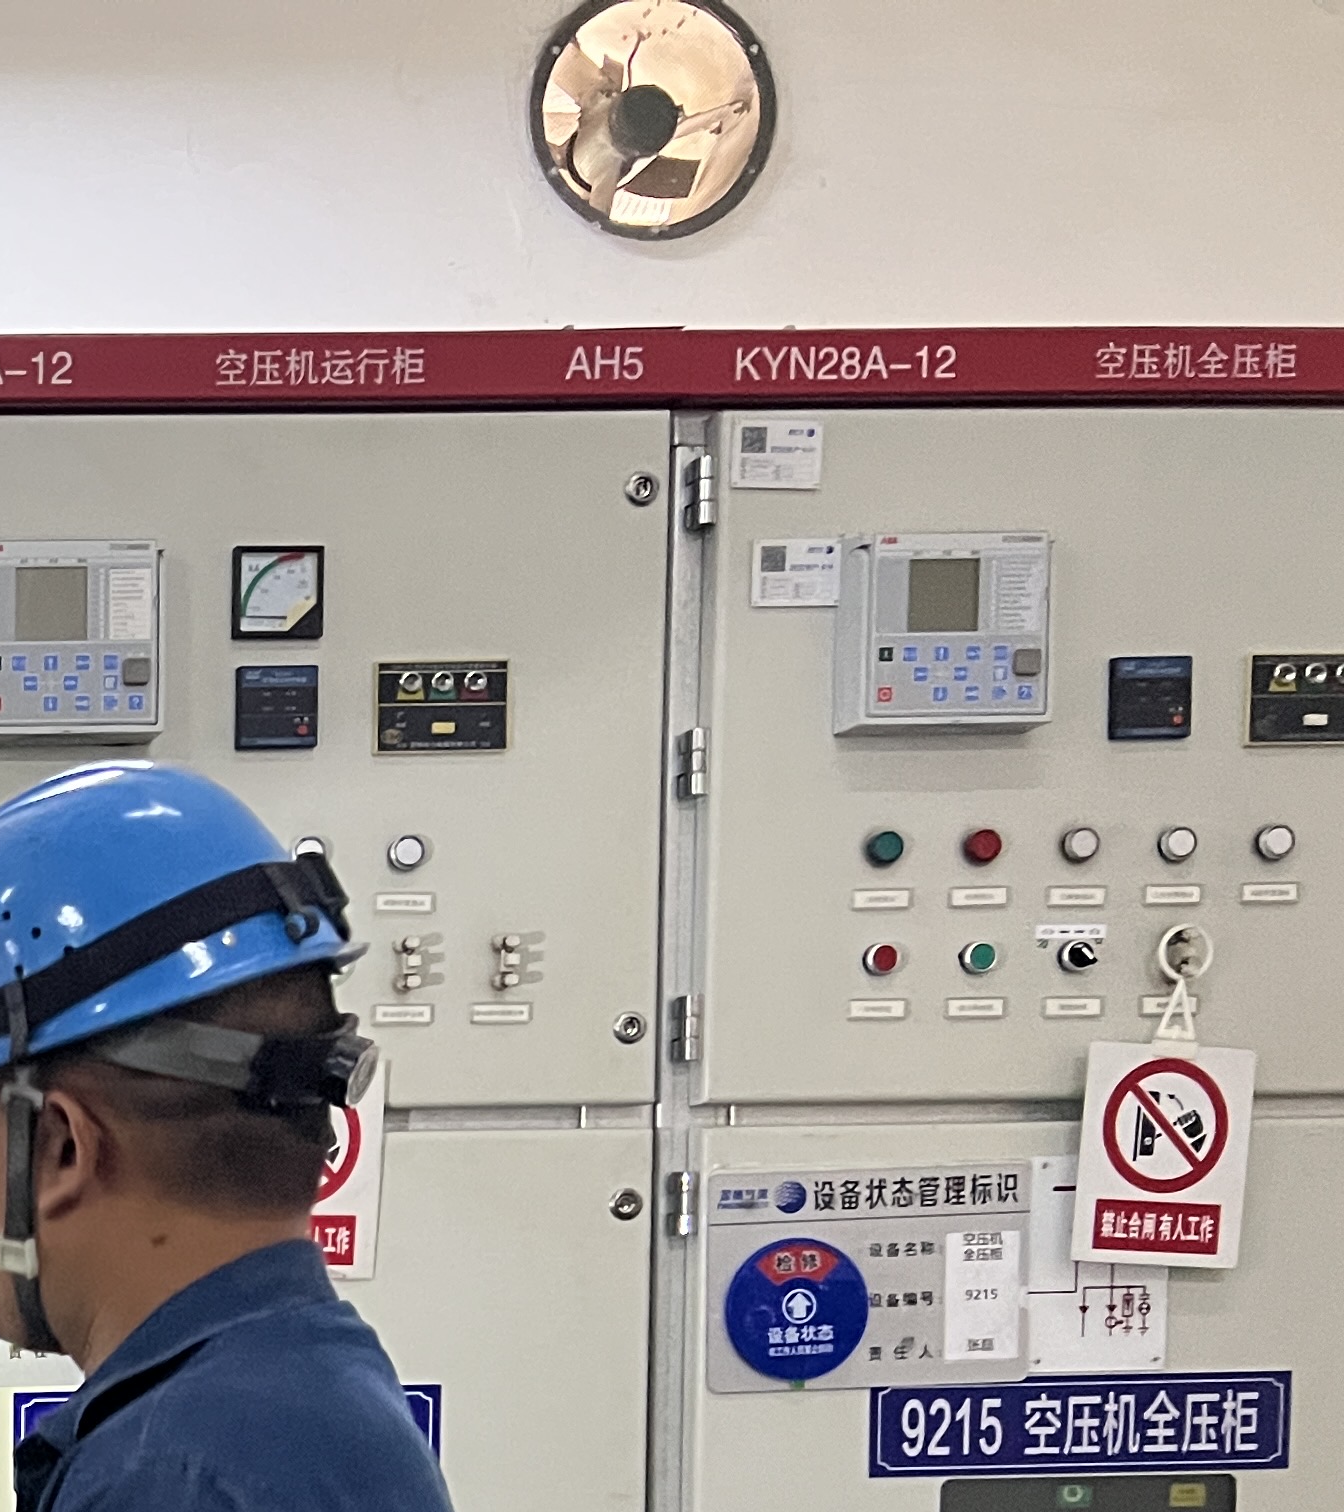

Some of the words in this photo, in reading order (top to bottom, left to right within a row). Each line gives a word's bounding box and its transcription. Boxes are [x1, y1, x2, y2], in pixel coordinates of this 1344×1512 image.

[215, 348, 425, 387] 空压机运行柜
[565, 346, 644, 381] AH5
[734, 344, 957, 382] KYN28A-12
[1095, 342, 1297, 381] 空压机全压柜
[813, 1173, 1020, 1212] 设备状态管理标识
[965, 1288, 998, 1301] 9215
[901, 1398, 1003, 1458] 9215
[1024, 1390, 1259, 1456] 空压机全压柜
